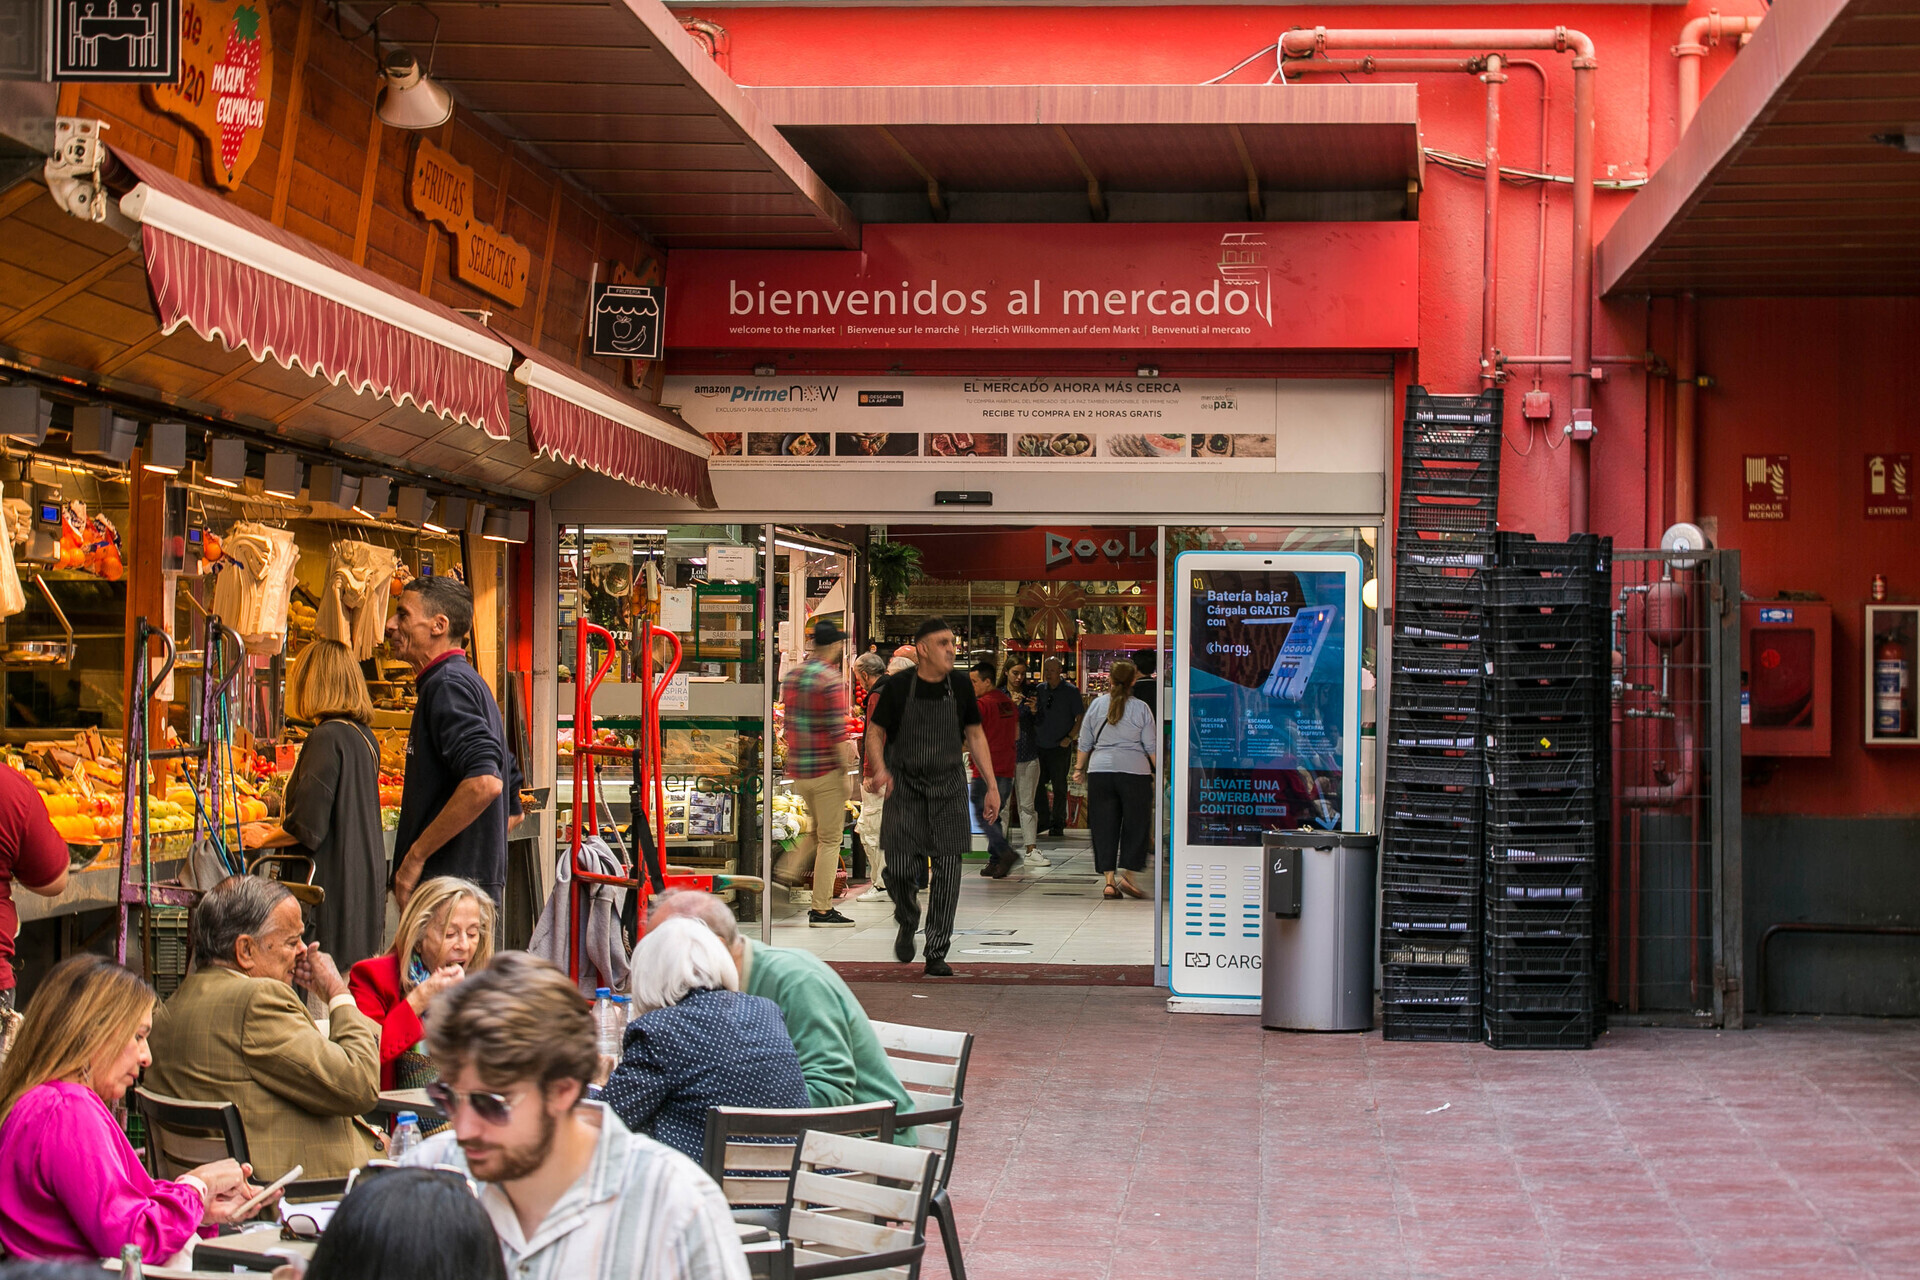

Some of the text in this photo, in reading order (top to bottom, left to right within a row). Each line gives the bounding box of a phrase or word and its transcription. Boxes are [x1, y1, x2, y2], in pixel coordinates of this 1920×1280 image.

[211, 54, 246, 94] mari
[216, 96, 265, 129] carmen
[422, 160, 466, 218] FRUTAS
[468, 233, 516, 290] SELECTAS
[729, 279, 1250, 316] bienvenidos al mercado
[729, 325, 836, 335] welcome to the market
[847, 325, 960, 335] Bienvenue sur le marché
[971, 325, 1140, 336] Herzlich Willkommen auf dem Markt
[1151, 325, 1251, 336] Benvenuti al mercato
[964, 380, 1182, 393] EL MERCADO AHORA MÁS CERCA
[694, 385, 731, 394] amazon
[730, 385, 788, 403] Prime
[1213, 401, 1234, 411] paz
[1031, 410, 1070, 418] COMPRA
[1073, 410, 1086, 418] EN
[1087, 410, 1094, 418] 2
[1095, 410, 1128, 418] HORAS
[1129, 410, 1162, 418] GRATIS
[1749, 503, 1783, 511] BOCA DE
[1867, 506, 1908, 515] EXTINTOR
[1748, 511, 1784, 519] INCENDIO
[1207, 590, 1289, 605] Batería baja?
[726, 604, 752, 612] VIERNES
[1207, 605, 1290, 617] Cárgala GRATIS
[1206, 617, 1227, 627] con
[651, 770, 763, 795] ercado
[1200, 777, 1280, 790] LLÉVATE UNA
[1200, 791, 1277, 804] POWERBANK
[1200, 804, 1254, 815] CONTIGO
